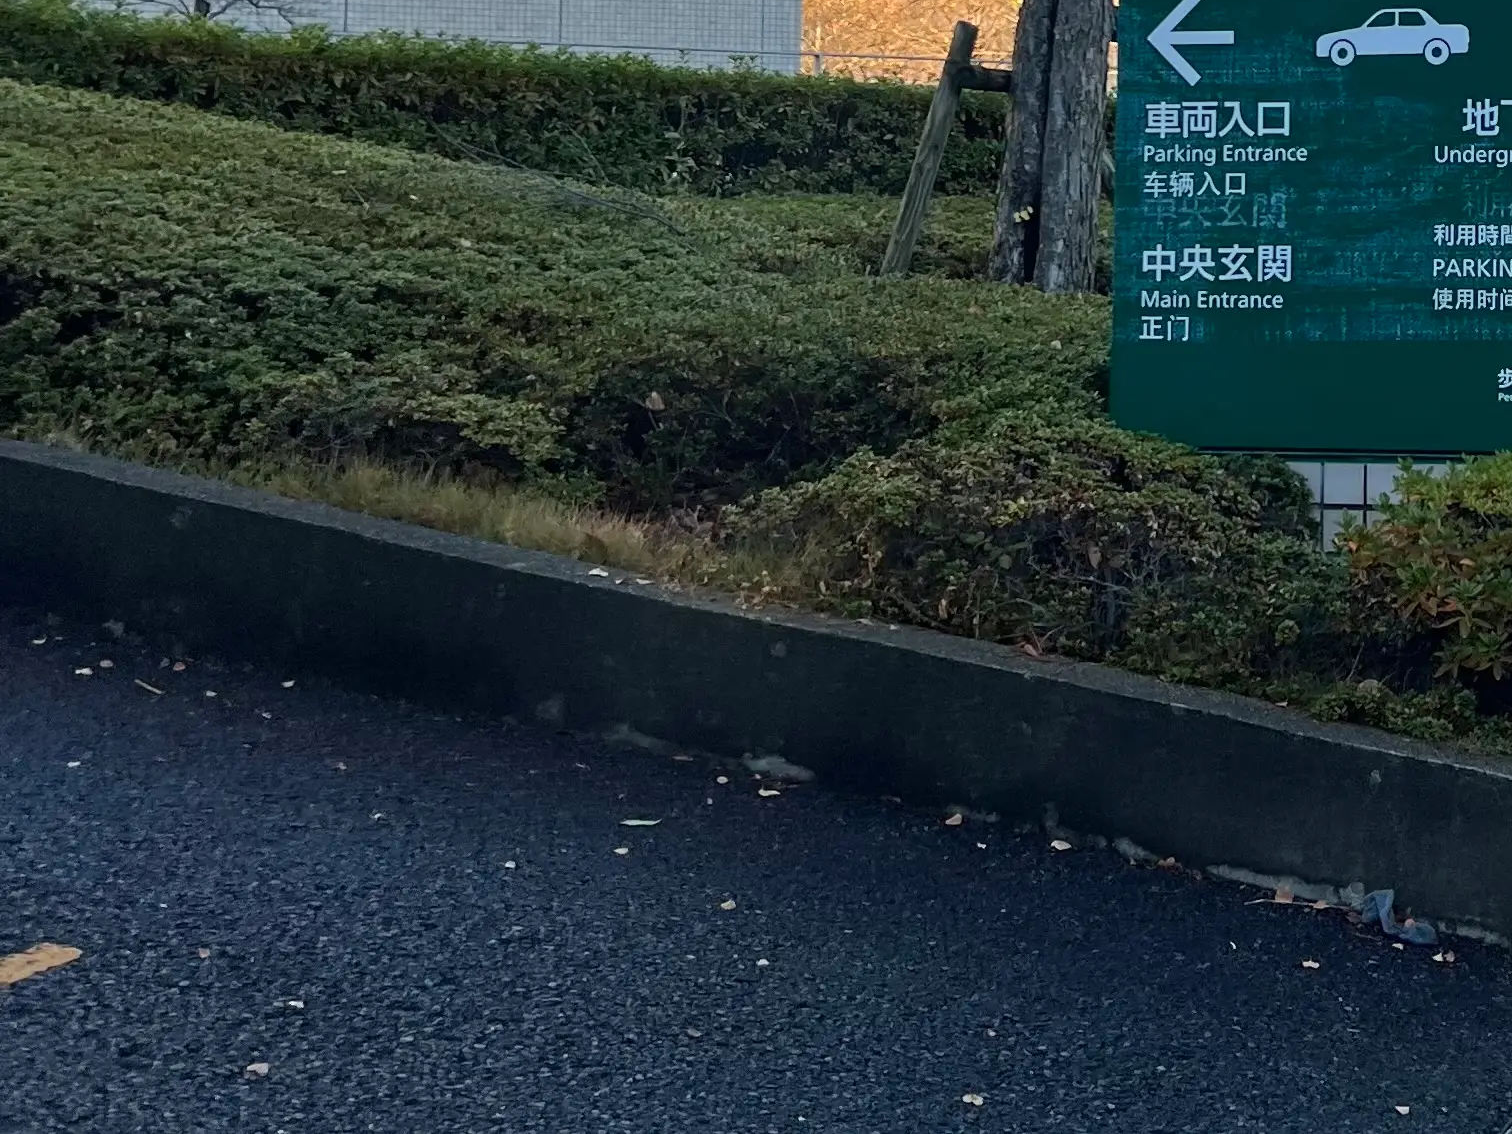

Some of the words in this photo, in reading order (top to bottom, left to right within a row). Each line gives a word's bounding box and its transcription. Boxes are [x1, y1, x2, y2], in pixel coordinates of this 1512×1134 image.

[1145, 101, 1291, 139] 車両入口
[1144, 143, 1216, 166] Parking
[1222, 143, 1308, 163] Entrance
[1143, 171, 1246, 198] 车辆入口
[1141, 243, 1292, 283] 中央玄関
[1140, 290, 1191, 309] Main
[1197, 290, 1284, 309] Entrance
[1139, 315, 1190, 342] 正门
